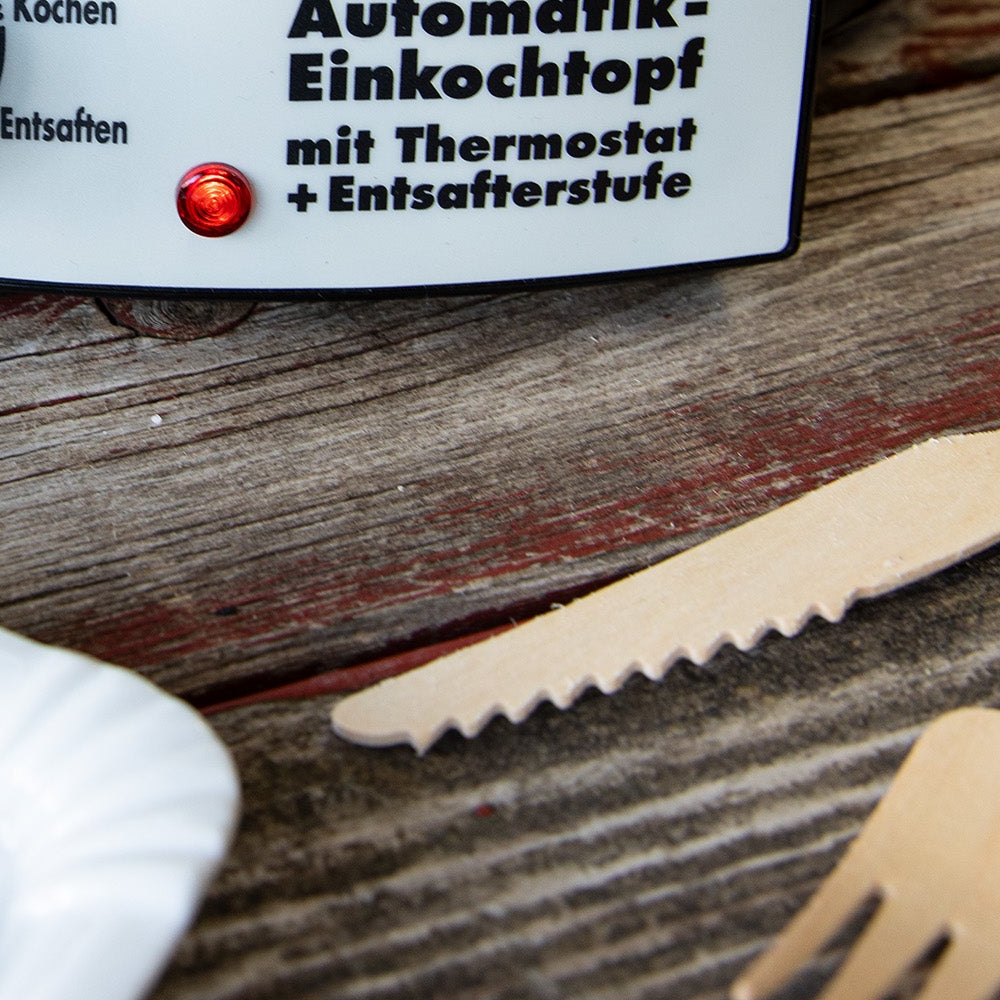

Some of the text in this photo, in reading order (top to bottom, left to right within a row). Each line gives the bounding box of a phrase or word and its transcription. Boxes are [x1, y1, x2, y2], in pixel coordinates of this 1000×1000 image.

[287, 36, 706, 106] Einkochtopf
[0, 105, 128, 145] Entsaften
[286, 117, 698, 166] mit Thermostat
